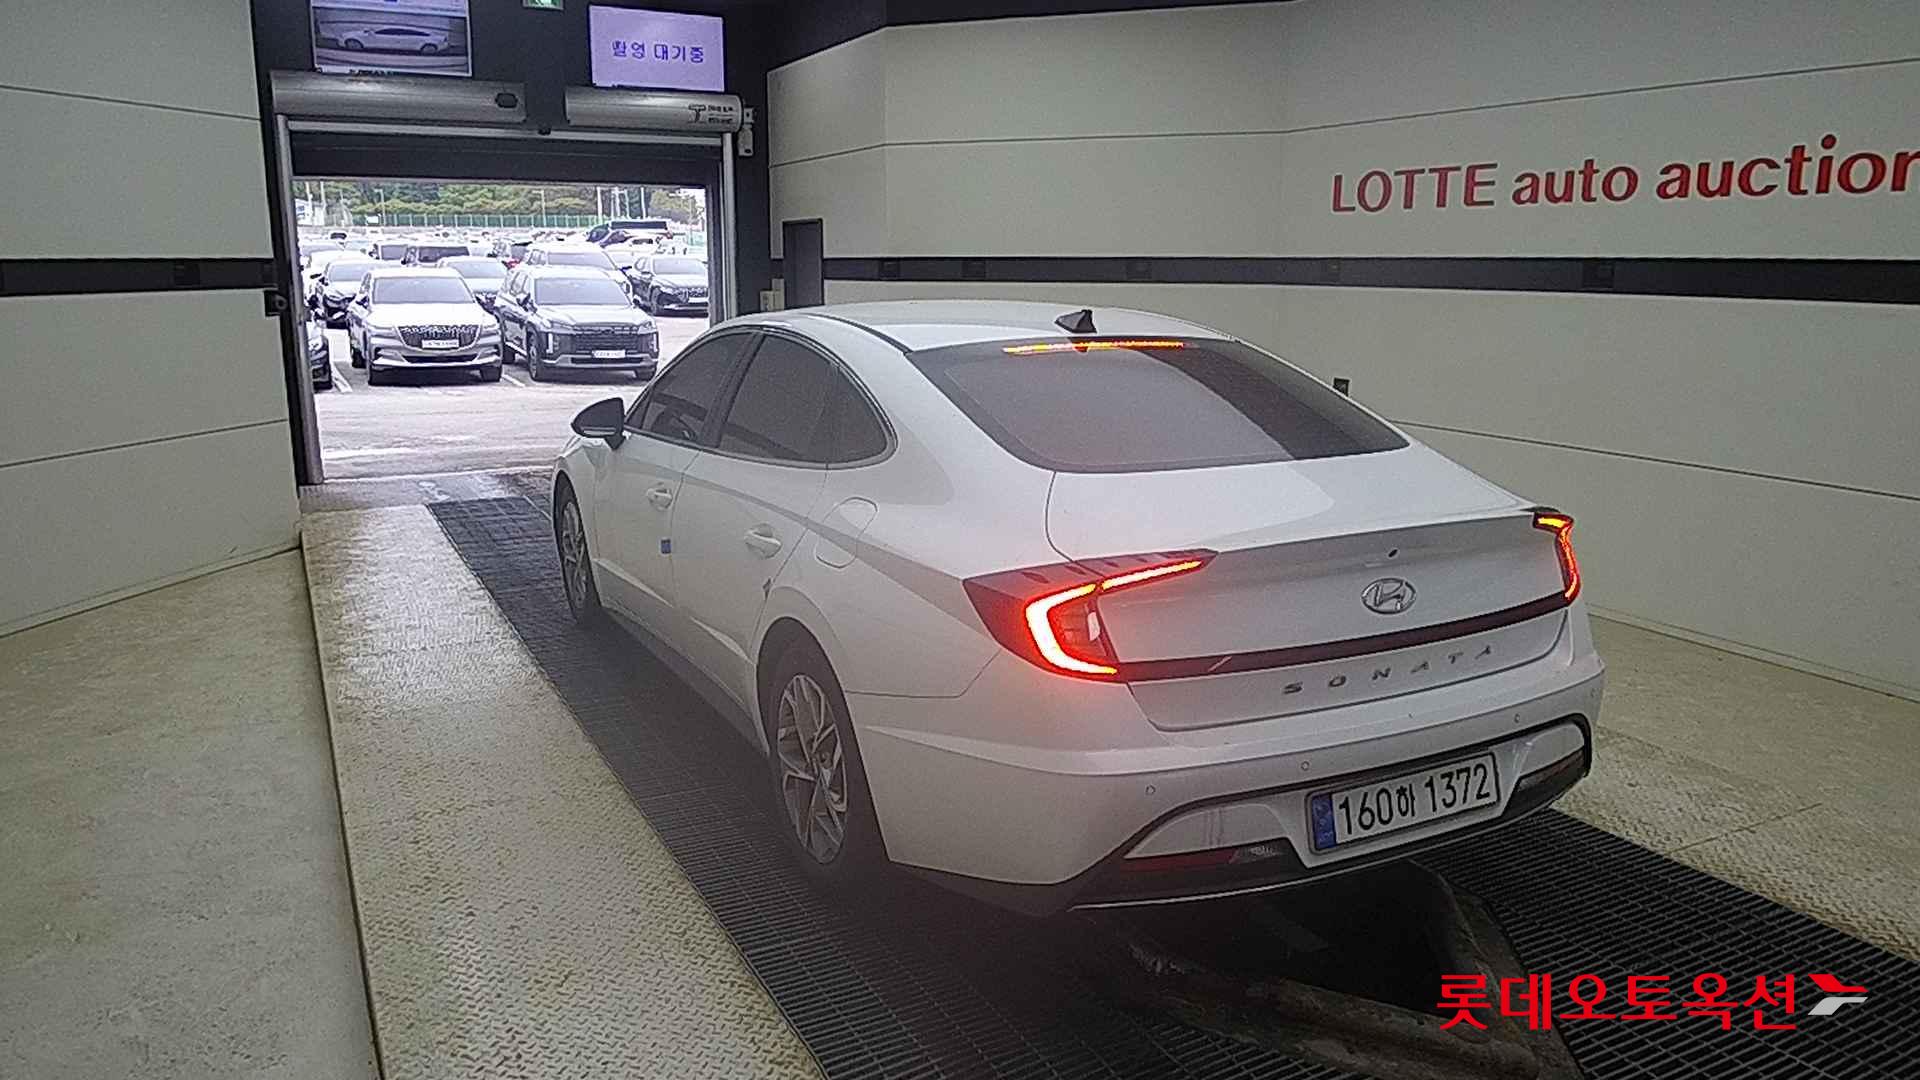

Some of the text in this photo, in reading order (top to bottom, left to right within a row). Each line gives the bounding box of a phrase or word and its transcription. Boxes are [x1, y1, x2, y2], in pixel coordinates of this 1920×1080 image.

[654, 44, 703, 63] 대기중
[1332, 162, 1498, 212] LOTTE
[1512, 157, 1639, 206] auto
[1283, 645, 1491, 694] SONATA
[1339, 763, 1490, 835] 160하 1372
